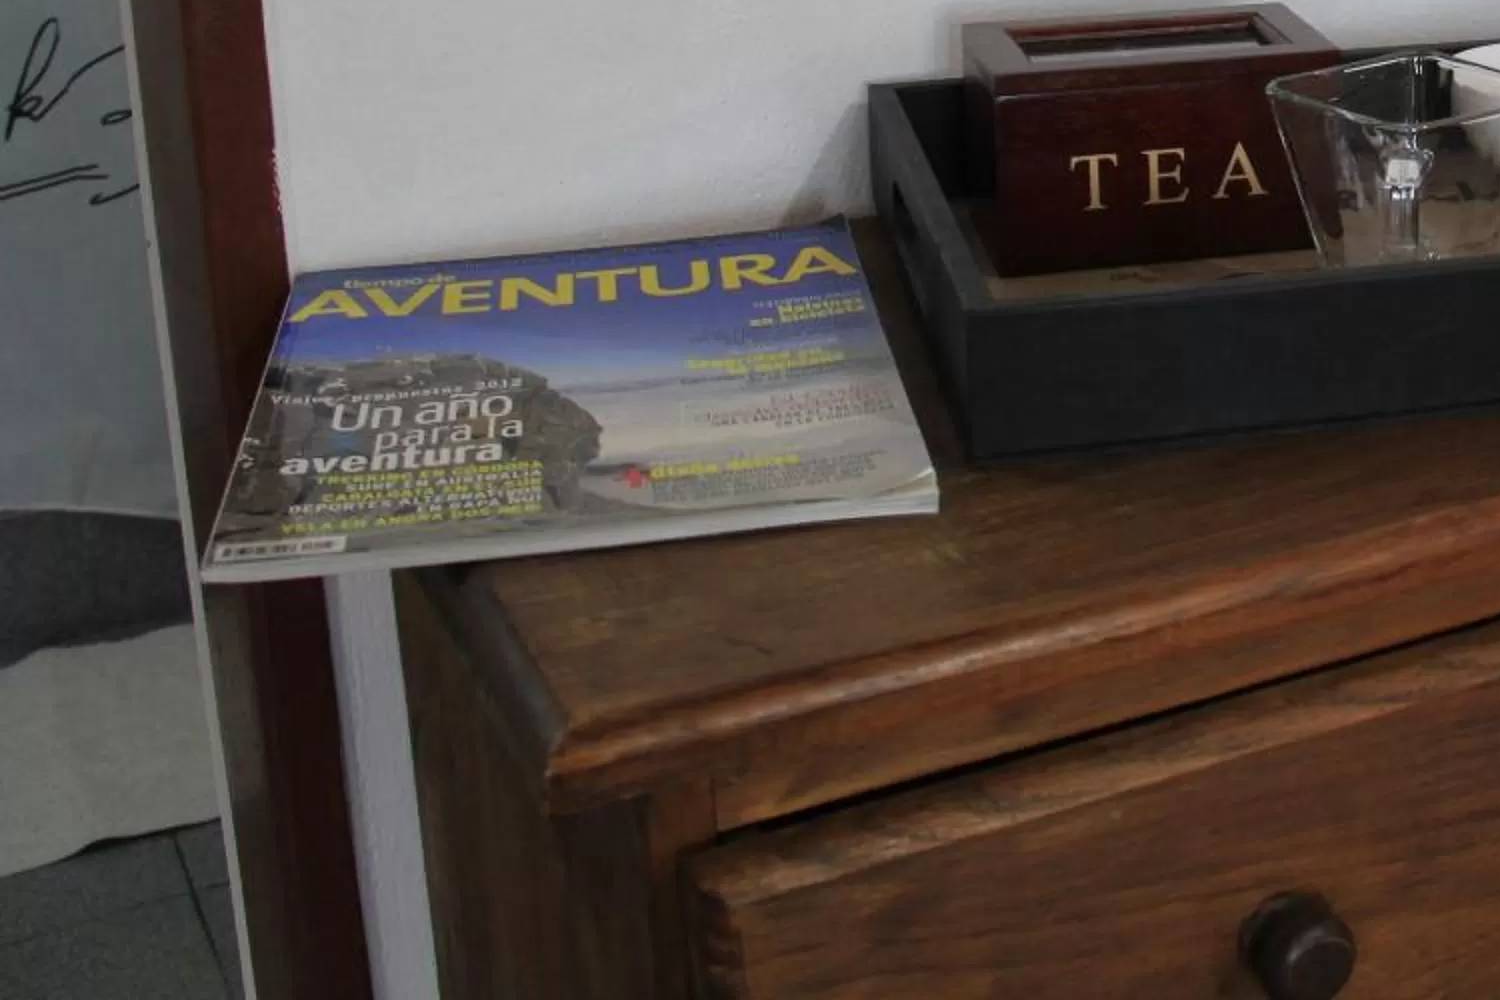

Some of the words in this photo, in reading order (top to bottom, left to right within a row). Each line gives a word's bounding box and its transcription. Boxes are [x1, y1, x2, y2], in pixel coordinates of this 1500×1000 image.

[1068, 140, 1270, 212] TEA
[288, 246, 857, 322] AVENTURA
[331, 403, 402, 431] Un
[415, 392, 513, 425] año
[374, 422, 473, 452] para
[486, 413, 523, 439] la
[279, 442, 502, 476] aventura
